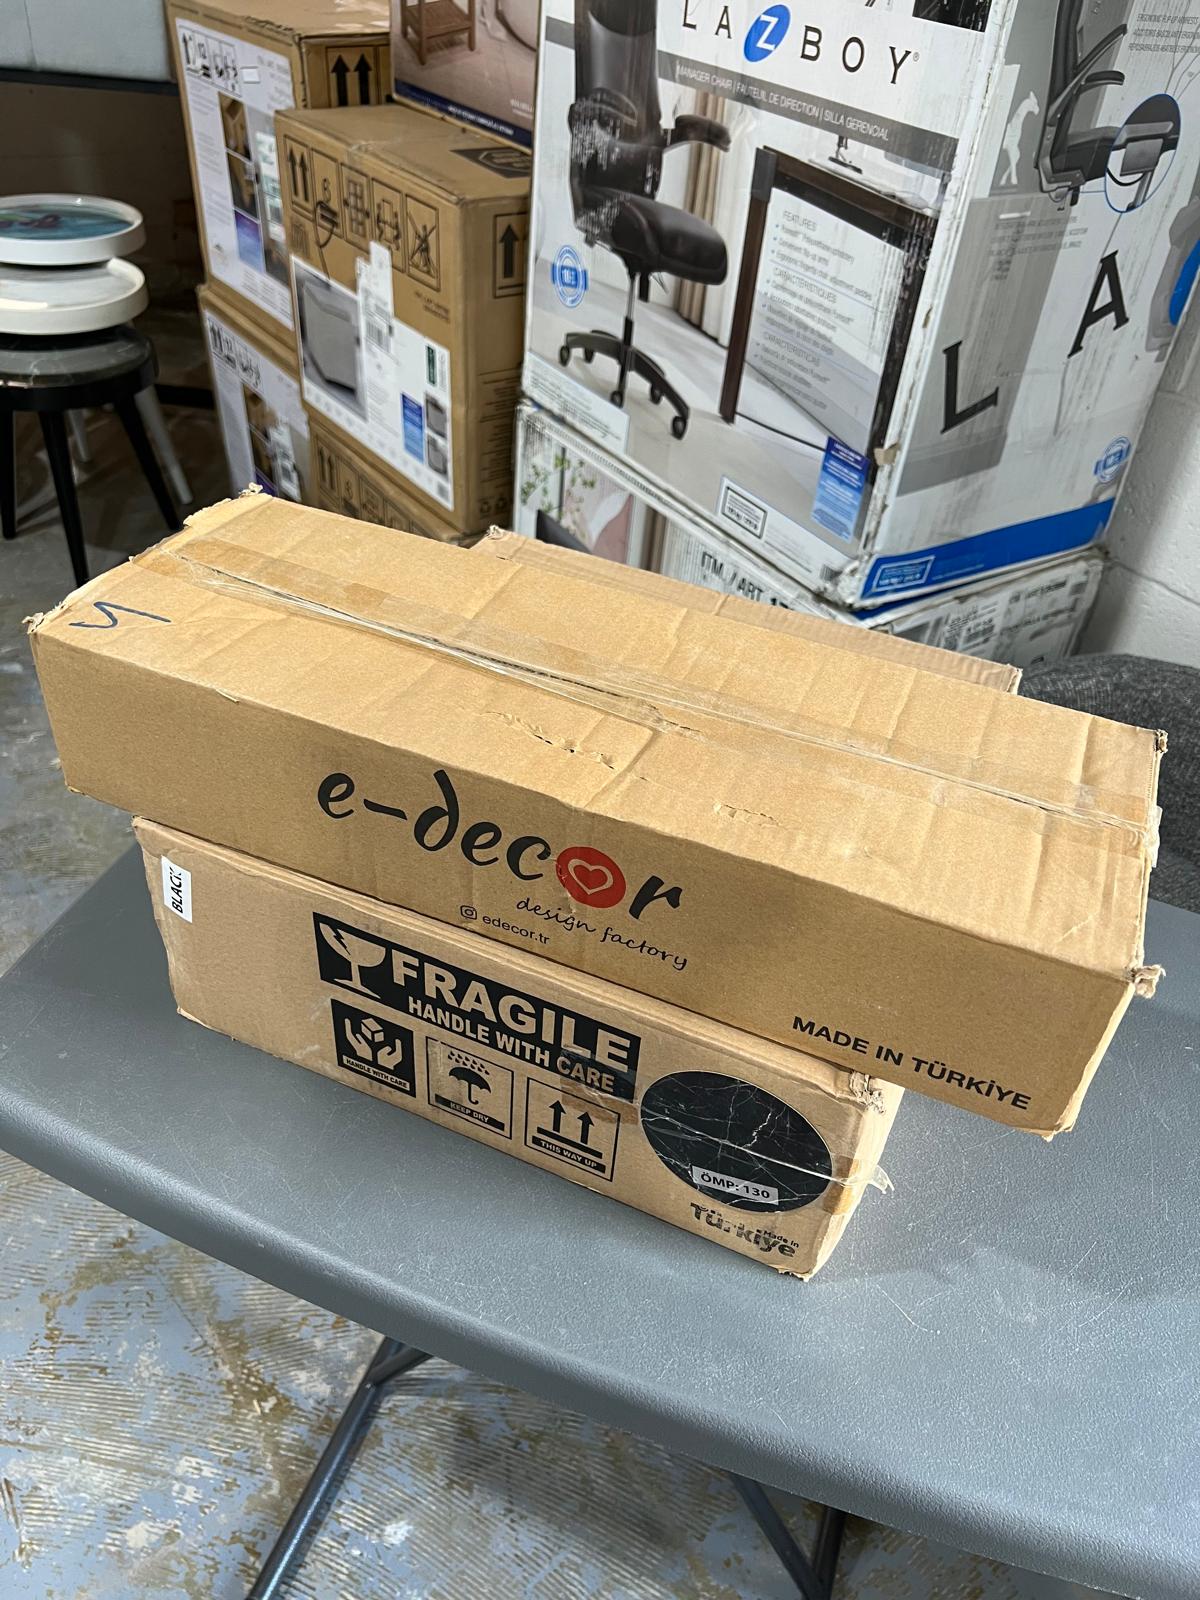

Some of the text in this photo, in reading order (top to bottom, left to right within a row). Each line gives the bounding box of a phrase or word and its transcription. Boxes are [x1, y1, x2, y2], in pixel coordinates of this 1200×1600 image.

[482, 913, 550, 945] edecor.tr
[516, 897, 689, 970] design factory
[391, 948, 632, 1073] FRAGILE
[408, 995, 615, 1093] HANDLE WITH CARE
[345, 1058, 408, 1089] HANDLE WITH CARE
[791, 1015, 1032, 1111] MADE IN TÜRKİYE
[450, 1101, 489, 1123] KEEP DRY
[541, 1139, 597, 1170] THIS WAY UP
[700, 1170, 771, 1200] ÖMP: 130
[763, 1228, 789, 1244] Made
